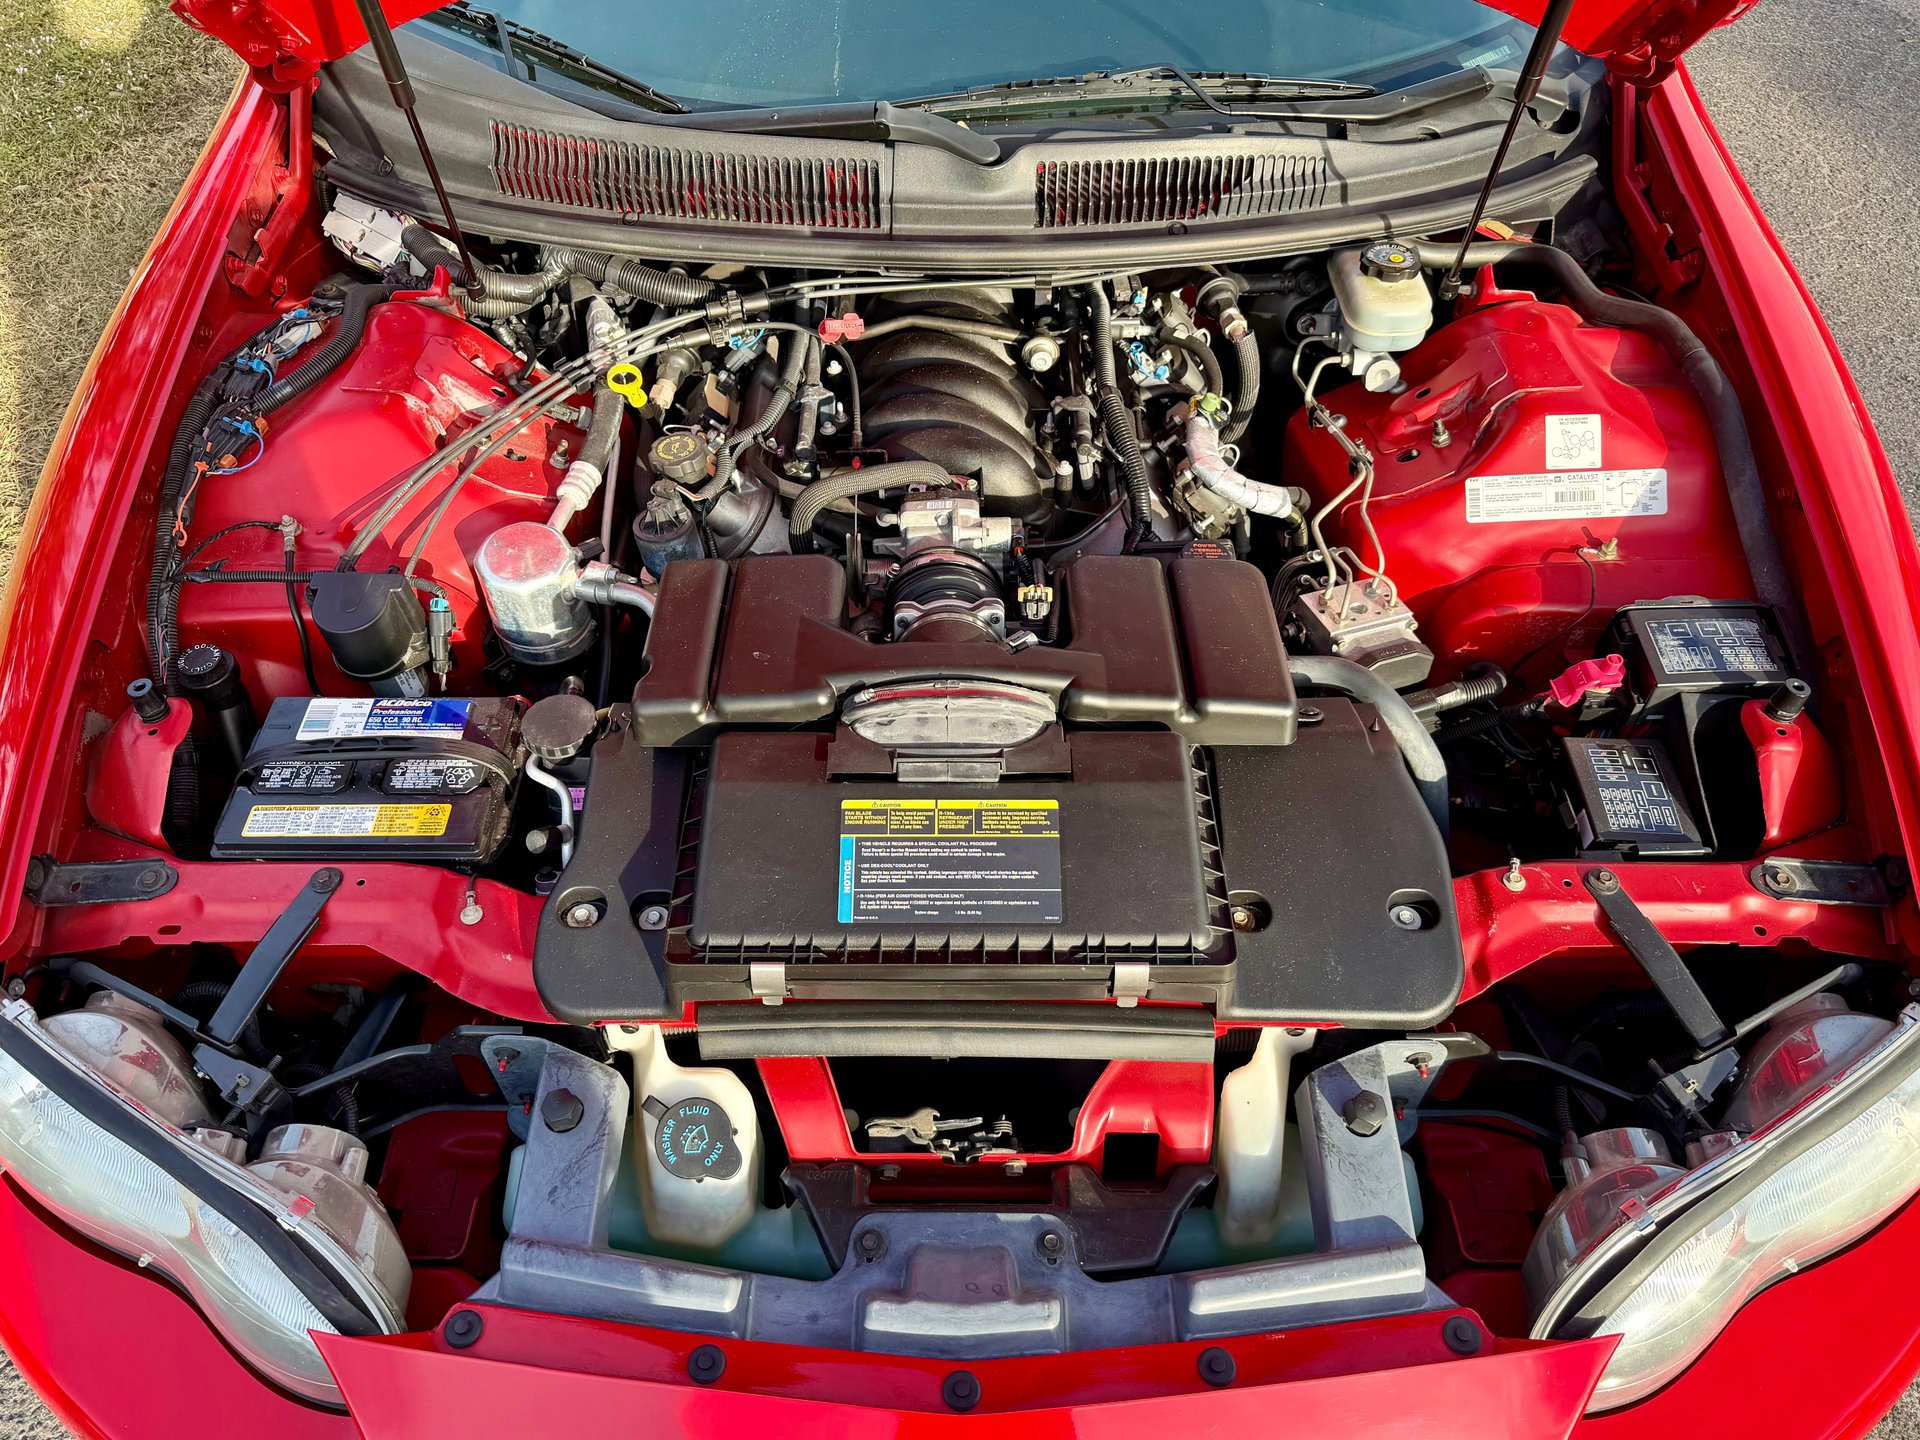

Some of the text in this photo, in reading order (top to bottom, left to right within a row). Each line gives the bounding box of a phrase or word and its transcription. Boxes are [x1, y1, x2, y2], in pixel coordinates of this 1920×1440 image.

[375, 699, 432, 707] ACDelco
[661, 1105, 724, 1167] WASHER FLUID ONLY
